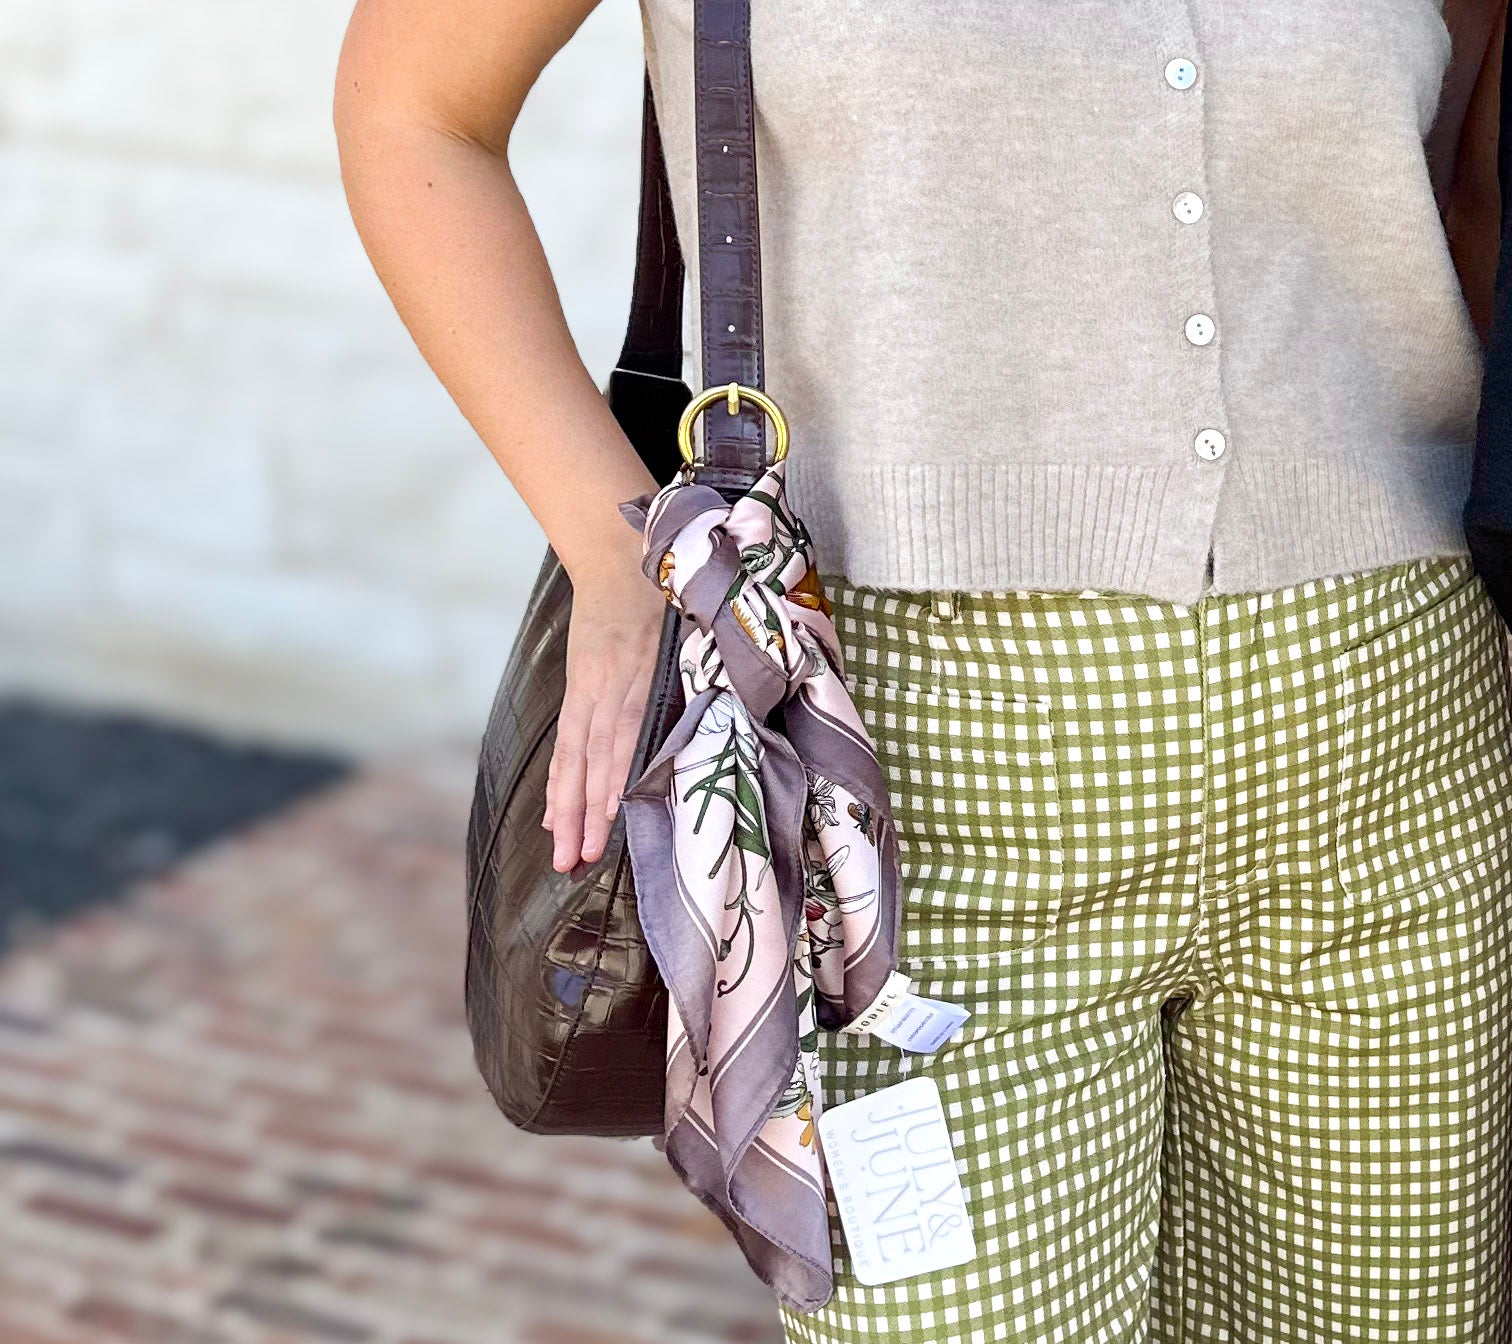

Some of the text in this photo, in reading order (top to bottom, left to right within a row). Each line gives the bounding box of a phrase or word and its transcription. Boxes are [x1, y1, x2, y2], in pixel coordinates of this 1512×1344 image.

[826, 1130, 869, 1267] WOMENS BOUTIQUE
[851, 1128, 926, 1262] JUNE
